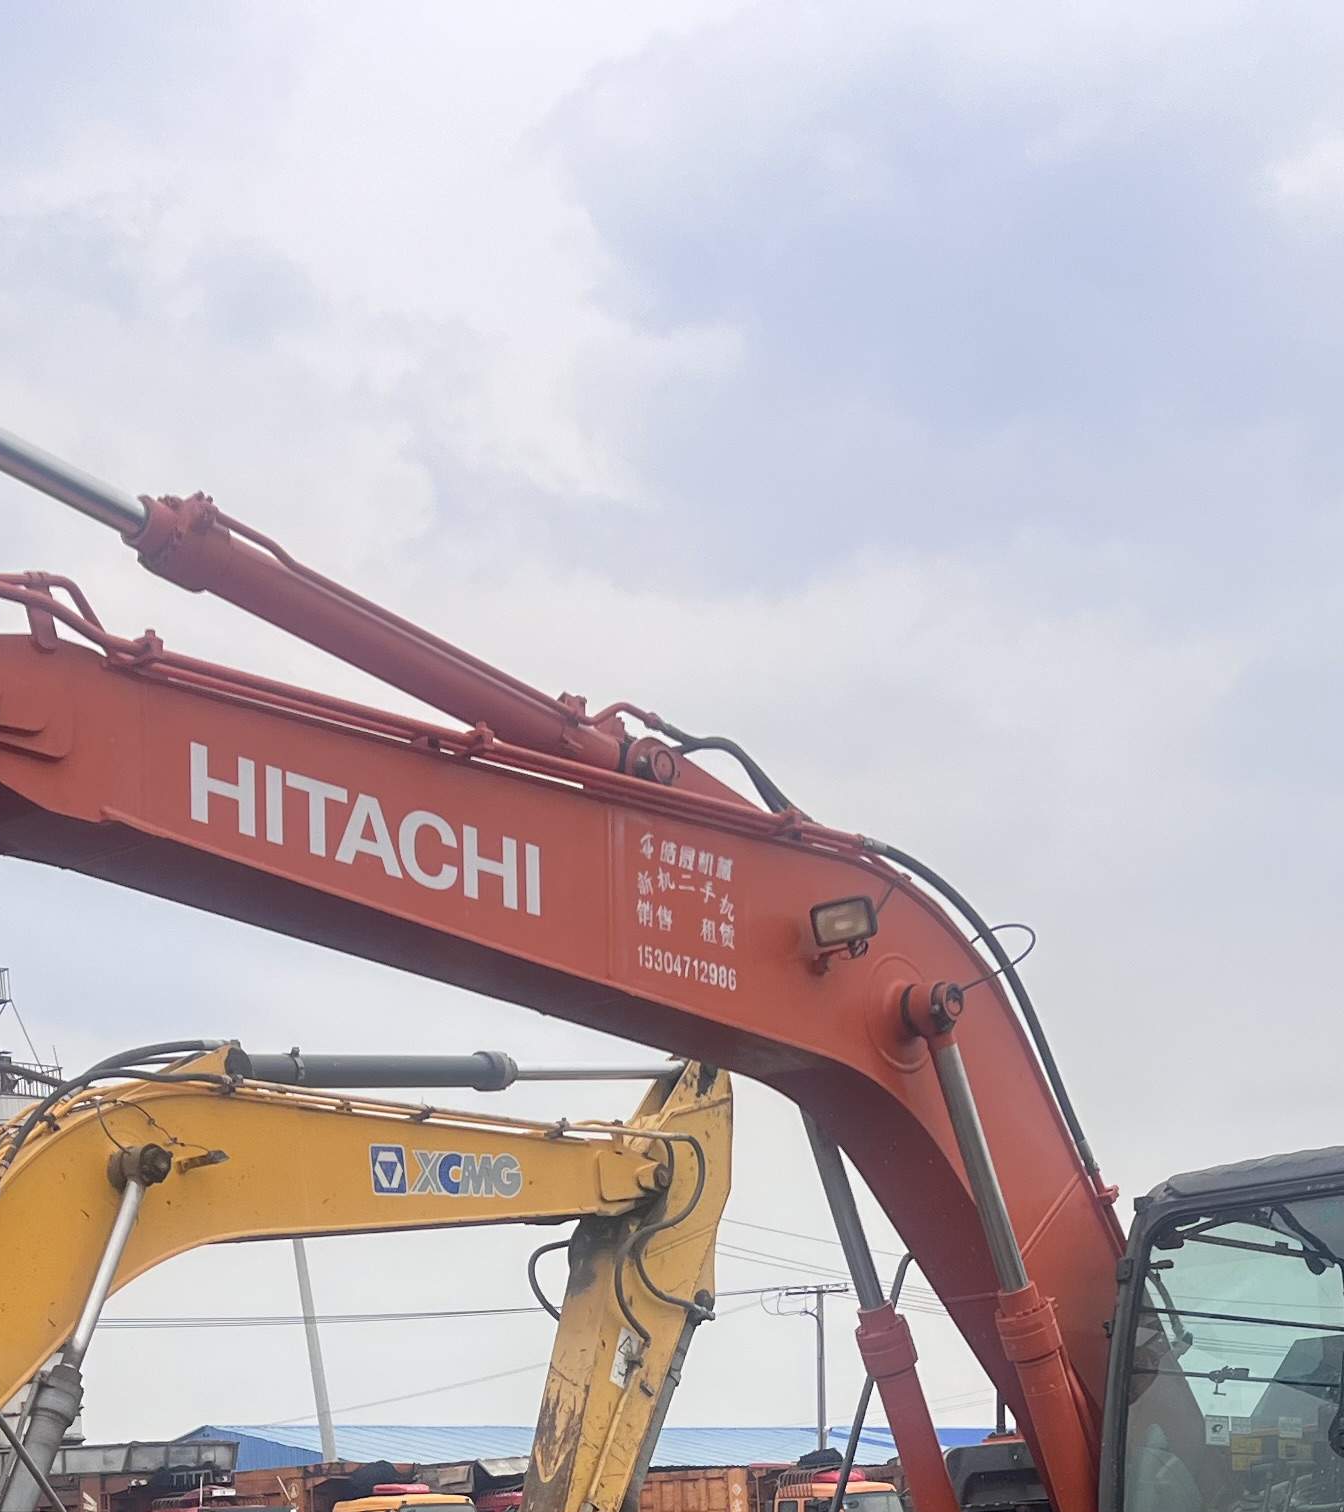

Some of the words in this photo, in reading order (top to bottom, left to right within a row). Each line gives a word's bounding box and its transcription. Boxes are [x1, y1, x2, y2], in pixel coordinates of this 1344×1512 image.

[190, 741, 541, 916] HITACHI
[637, 944, 737, 991] 15304712986
[410, 1150, 523, 1198] XCMG
